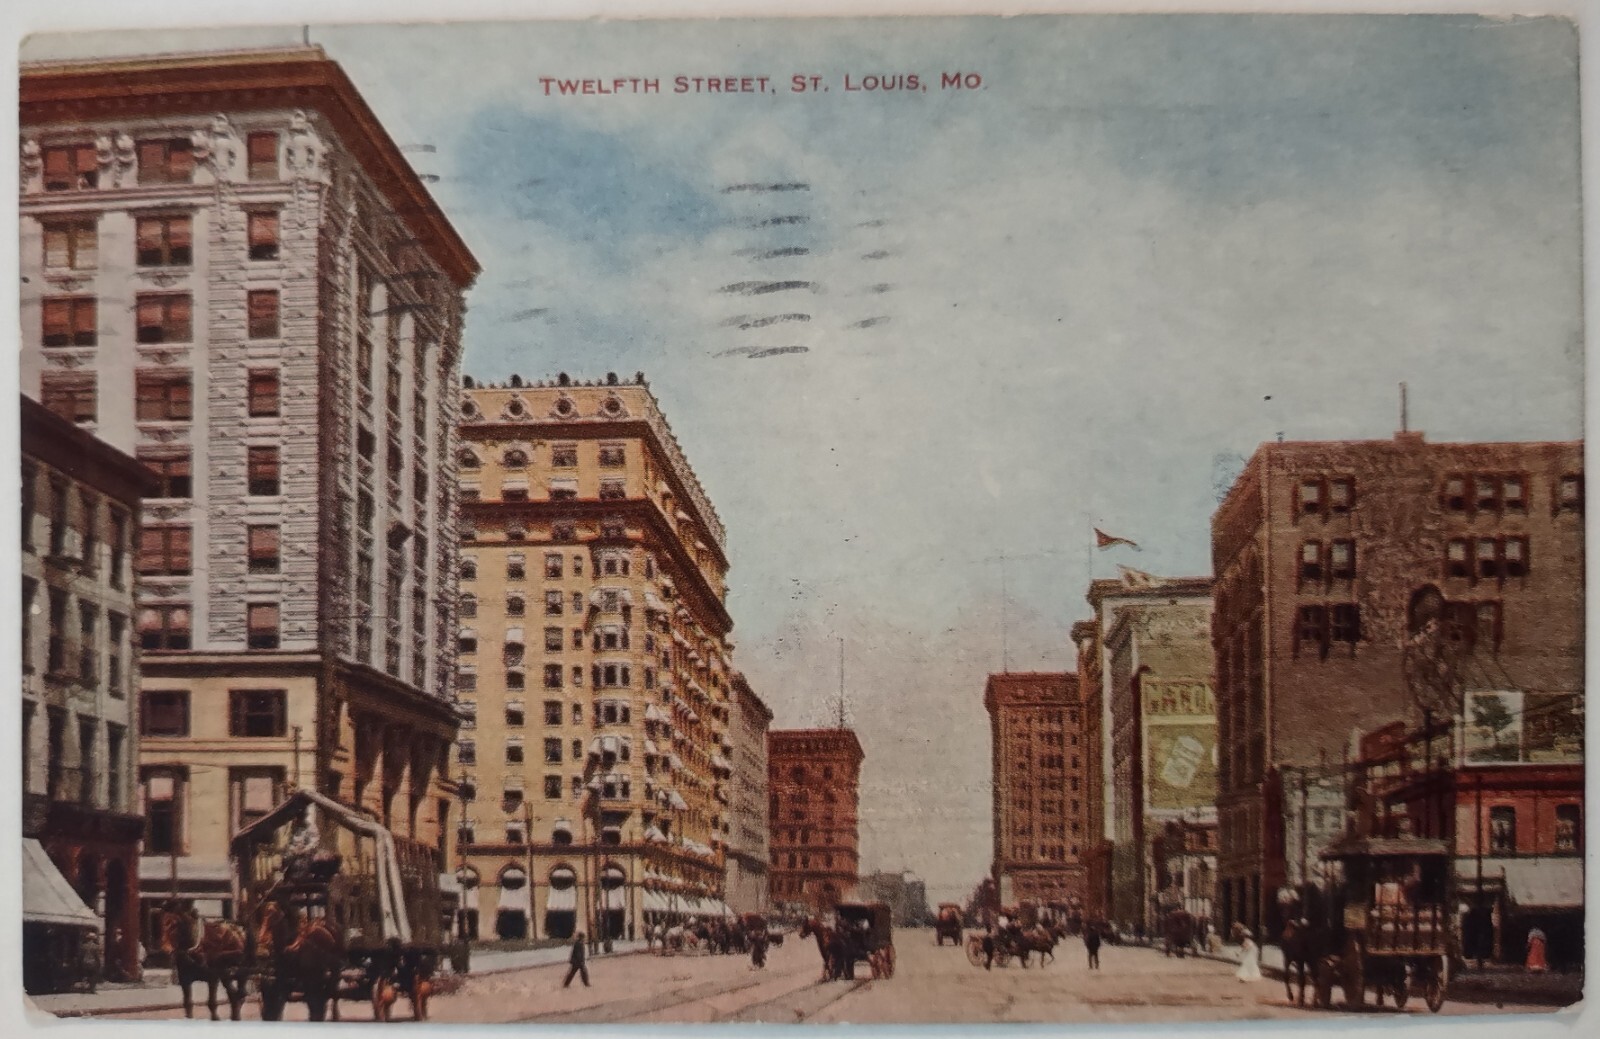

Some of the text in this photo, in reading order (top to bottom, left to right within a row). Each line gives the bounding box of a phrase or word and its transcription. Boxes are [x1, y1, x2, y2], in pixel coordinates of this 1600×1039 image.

[539, 77, 660, 96] TWELFTH
[673, 76, 776, 95] STREET,
[791, 74, 829, 93] ST.
[844, 73, 927, 93] LOUIS,
